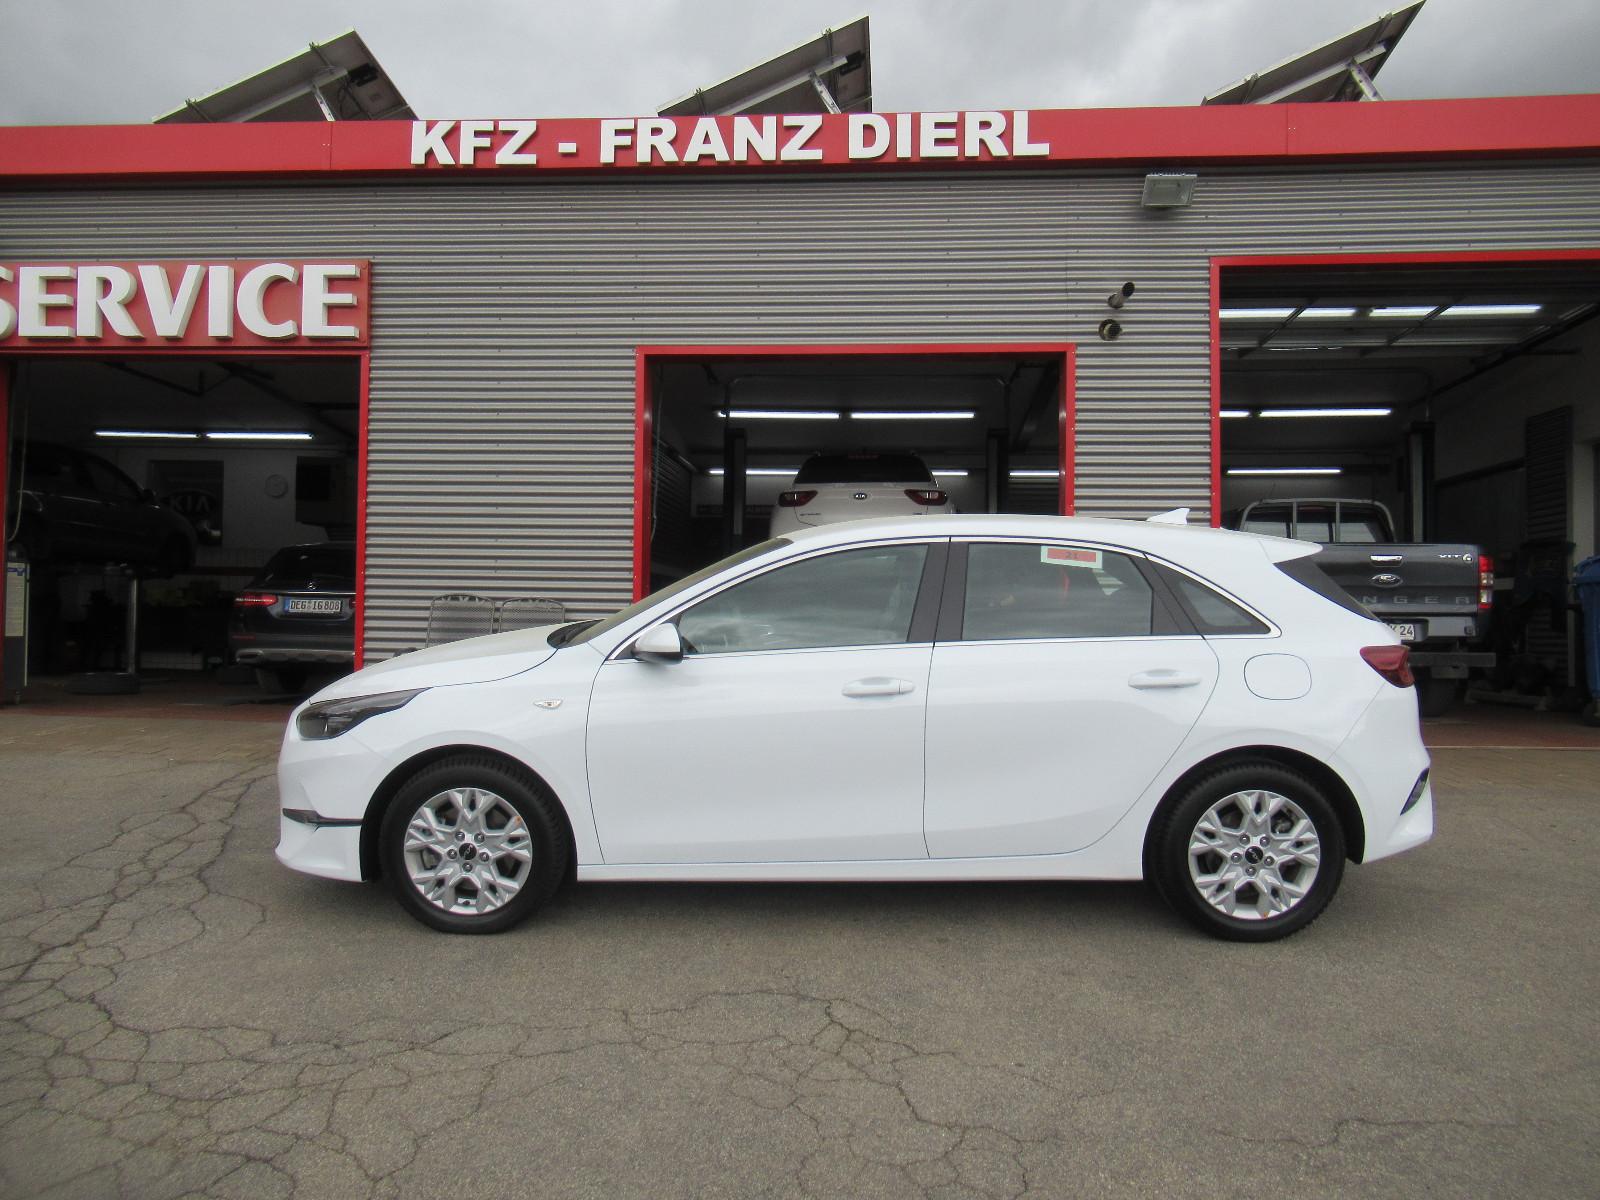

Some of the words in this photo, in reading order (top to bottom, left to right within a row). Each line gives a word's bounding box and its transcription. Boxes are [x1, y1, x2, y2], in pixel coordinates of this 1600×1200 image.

[410, 119, 537, 166] KFZ
[599, 114, 823, 164] FRANZ
[848, 110, 1050, 160] DIERL
[1362, 595, 1470, 605] NGER
